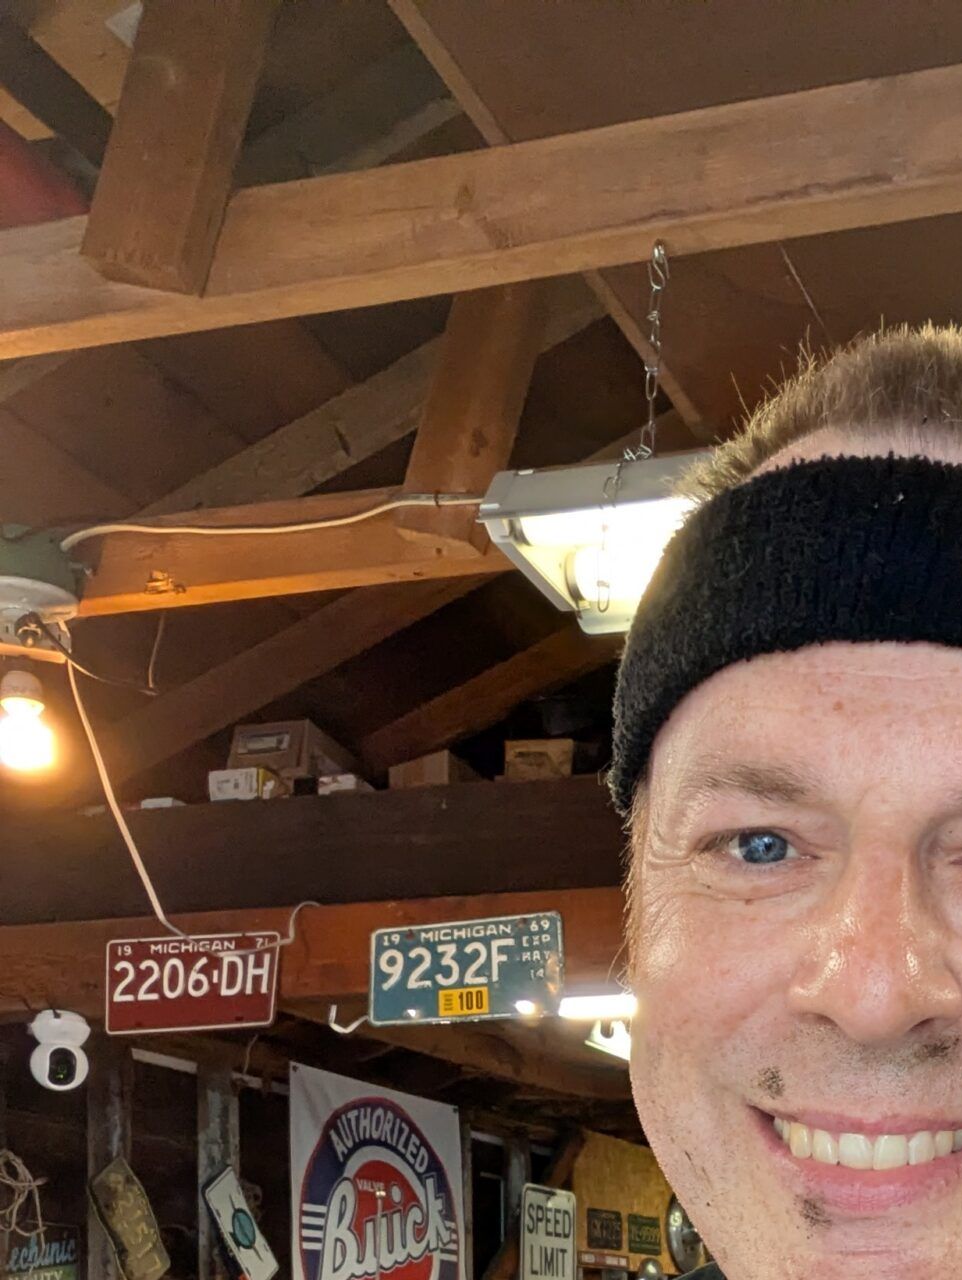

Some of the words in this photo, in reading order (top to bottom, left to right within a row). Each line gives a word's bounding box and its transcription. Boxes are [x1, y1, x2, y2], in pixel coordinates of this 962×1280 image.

[117, 944, 133, 957] 19
[150, 939, 236, 955] MICHIGAN
[384, 933, 401, 947] 19
[420, 923, 512, 943] MICHIGAN
[529, 919, 551, 933] 69
[379, 937, 516, 992] 9232F
[458, 989, 484, 1011] 100
[328, 1106, 430, 1175] AUTHORIZED
[526, 1203, 572, 1240] SPEED
[530, 1244, 568, 1278] LIMIT
